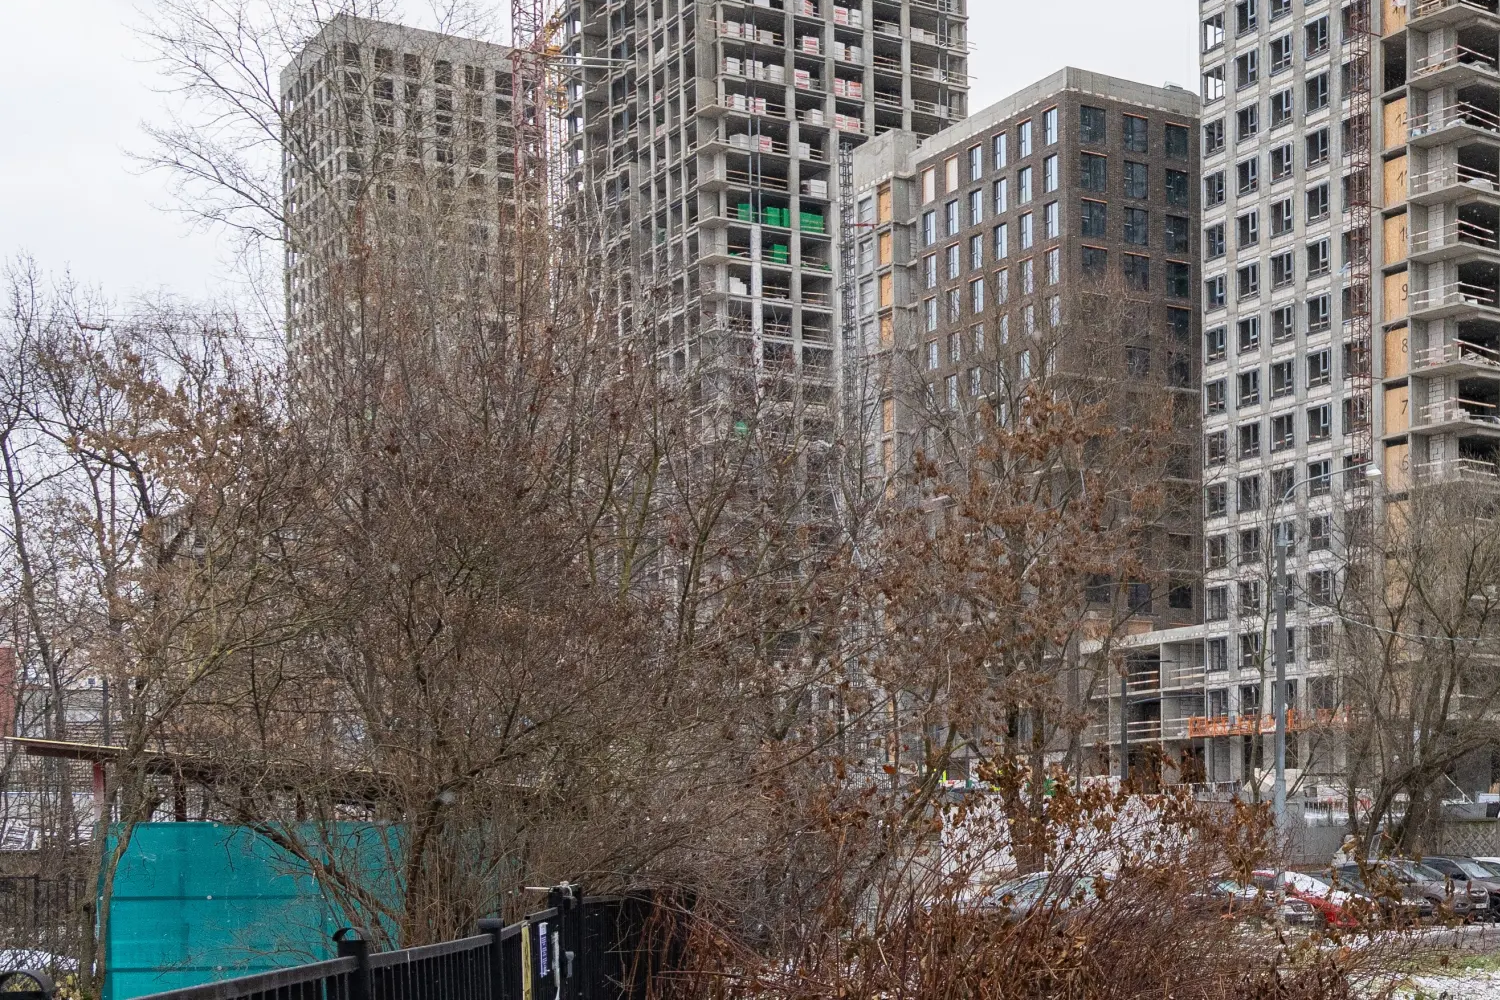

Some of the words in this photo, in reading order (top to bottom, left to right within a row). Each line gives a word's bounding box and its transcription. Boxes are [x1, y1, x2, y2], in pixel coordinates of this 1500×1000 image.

[1402, 283, 1408, 300] 9
[1402, 338, 1408, 353] 8
[1402, 399, 1408, 415] 7
[1402, 453, 1408, 471] 6
